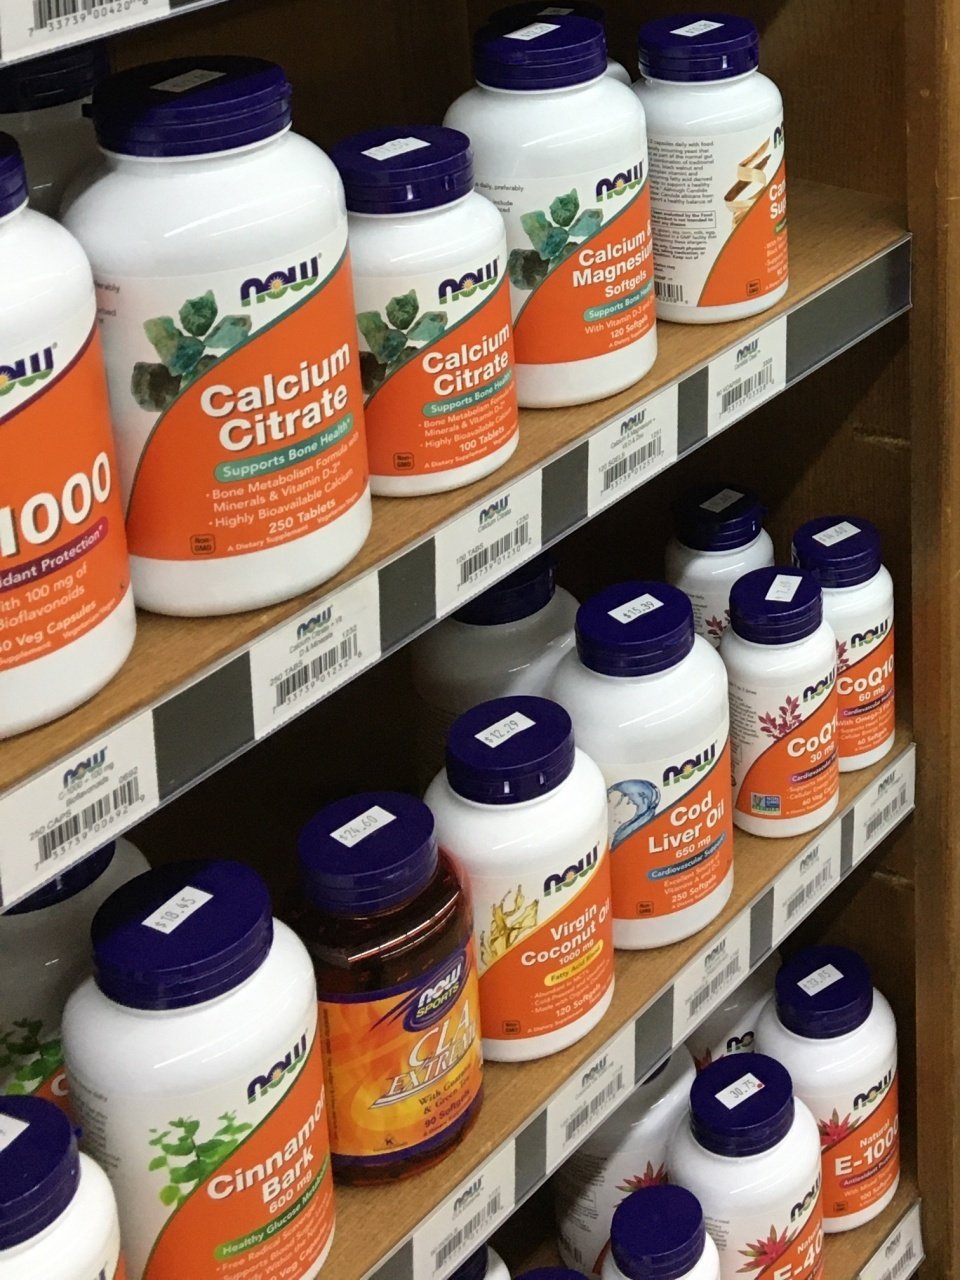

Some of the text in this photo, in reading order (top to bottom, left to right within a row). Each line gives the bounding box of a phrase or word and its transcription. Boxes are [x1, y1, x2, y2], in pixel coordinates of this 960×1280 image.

[579, 232, 646, 268] Calcium
[605, 270, 646, 299] Softgels
[589, 300, 624, 320] Supports
[422, 325, 510, 374] Calcium
[200, 343, 351, 418] Calcium
[434, 352, 509, 397] Citrate
[219, 384, 348, 451] Citrate
[431, 386, 492, 415] Supports Bone
[459, 426, 504, 453] 100 Tablets
[222, 440, 318, 478] Supports Bone
[213, 462, 314, 500] Bone Metabolism
[214, 475, 317, 513] Minerals Vitamin
[215, 489, 322, 529] Highly Bioavailable
[269, 498, 337, 535] 250 Tablets
[26, 575, 74, 603] 100 mg
[15, 599, 96, 647] Veg Capsules
[836, 655, 894, 695] CoQ10
[859, 692, 870, 702] 60
[787, 714, 838, 758] CoQ1
[810, 751, 823, 764] 30
[648, 799, 725, 855] Liver Oil
[670, 791, 712, 828] Cod
[651, 850, 703, 879] Cardiovascular
[676, 835, 711, 858] 650 mg
[521, 897, 610, 967] Coconut Oil
[550, 904, 597, 942] Virgin
[559, 946, 580, 965] 1000
[550, 967, 569, 984] Fatty
[416, 983, 459, 1020] SPORTS
[860, 1119, 890, 1149] Natural
[261, 1145, 314, 1205] Bark
[269, 1192, 294, 1215] 600
[223, 1204, 301, 1256] Healthy Glucose
